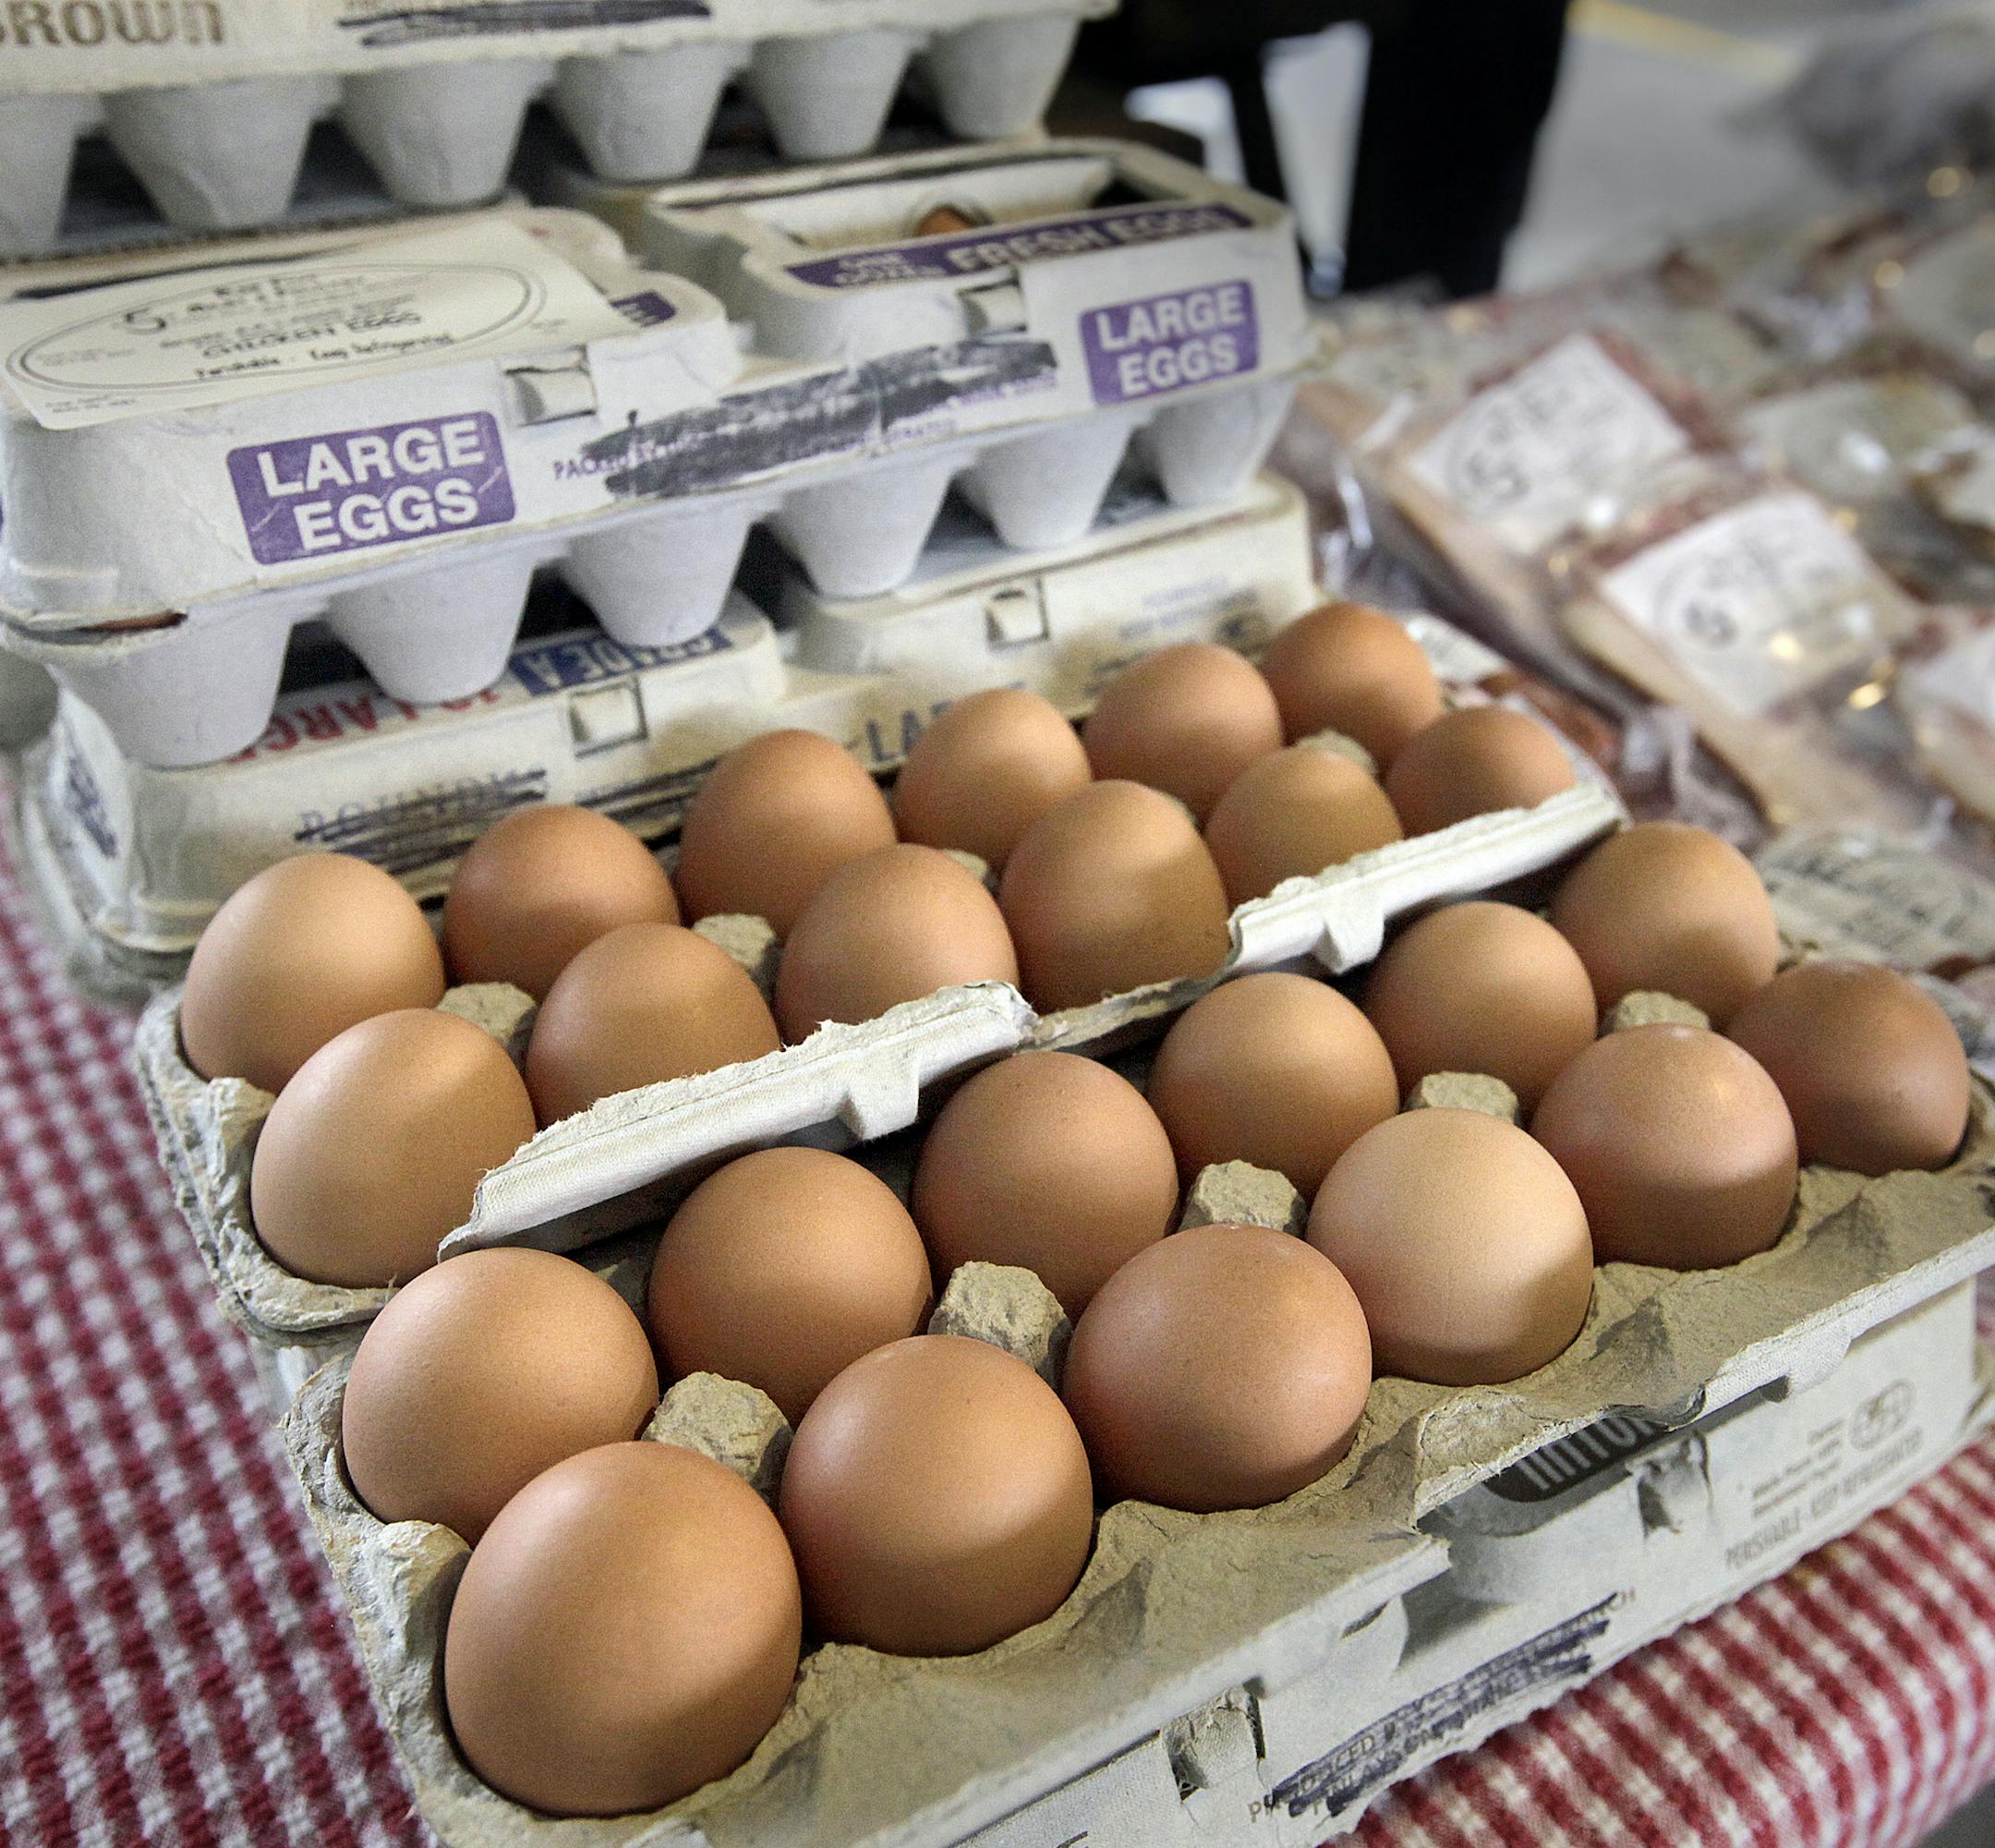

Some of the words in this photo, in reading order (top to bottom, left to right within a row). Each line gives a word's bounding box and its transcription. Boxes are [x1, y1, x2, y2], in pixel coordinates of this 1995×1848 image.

[0, 0, 224, 44] ROWN
[946, 224, 1107, 271] FRESH
[1106, 206, 1235, 244] EGGS
[1096, 286, 1246, 351] LARGE
[1118, 336, 1239, 394] EGGS
[257, 419, 485, 497] LARGE
[295, 477, 480, 551] EGGS
[228, 695, 420, 765] LARG
